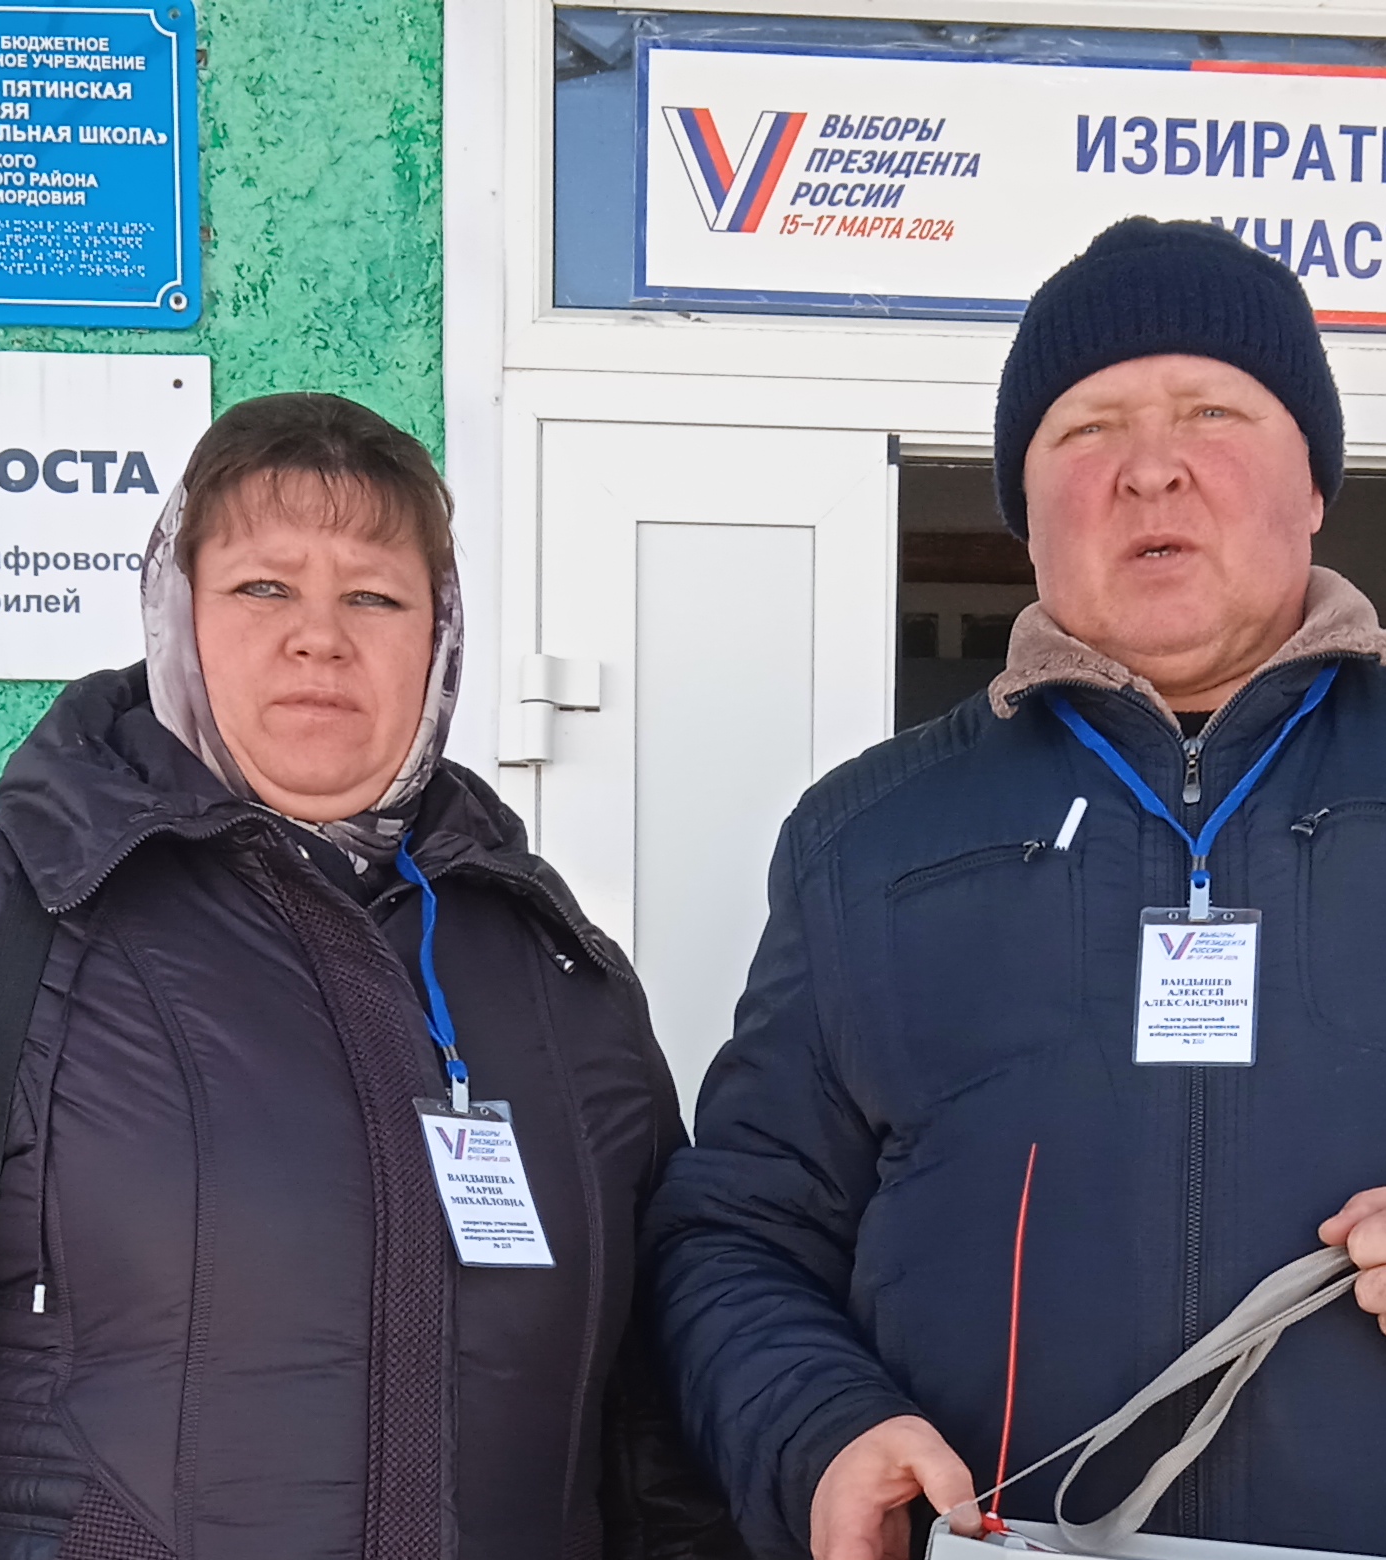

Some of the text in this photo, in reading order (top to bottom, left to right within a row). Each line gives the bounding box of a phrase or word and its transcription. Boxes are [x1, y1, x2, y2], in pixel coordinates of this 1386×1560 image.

[1, 35, 109, 52] БЮДЖЕТНОЕ
[33, 53, 145, 70] УЧРЕЖДЕНИЕ
[2, 80, 132, 100] ПЯТИНСКАЯ
[79, 126, 168, 145] ШКОЛА»
[819, 114, 946, 142] ВЫБОРЫ
[805, 148, 981, 179] ПРЕЗИДЕНТА
[30, 170, 98, 188] РАЙОНА
[790, 182, 905, 209] РОССИИ
[836, 217, 904, 239] МАРТА
[906, 218, 955, 241] 2024
[466, 1186, 503, 1195] МАРИЯ
